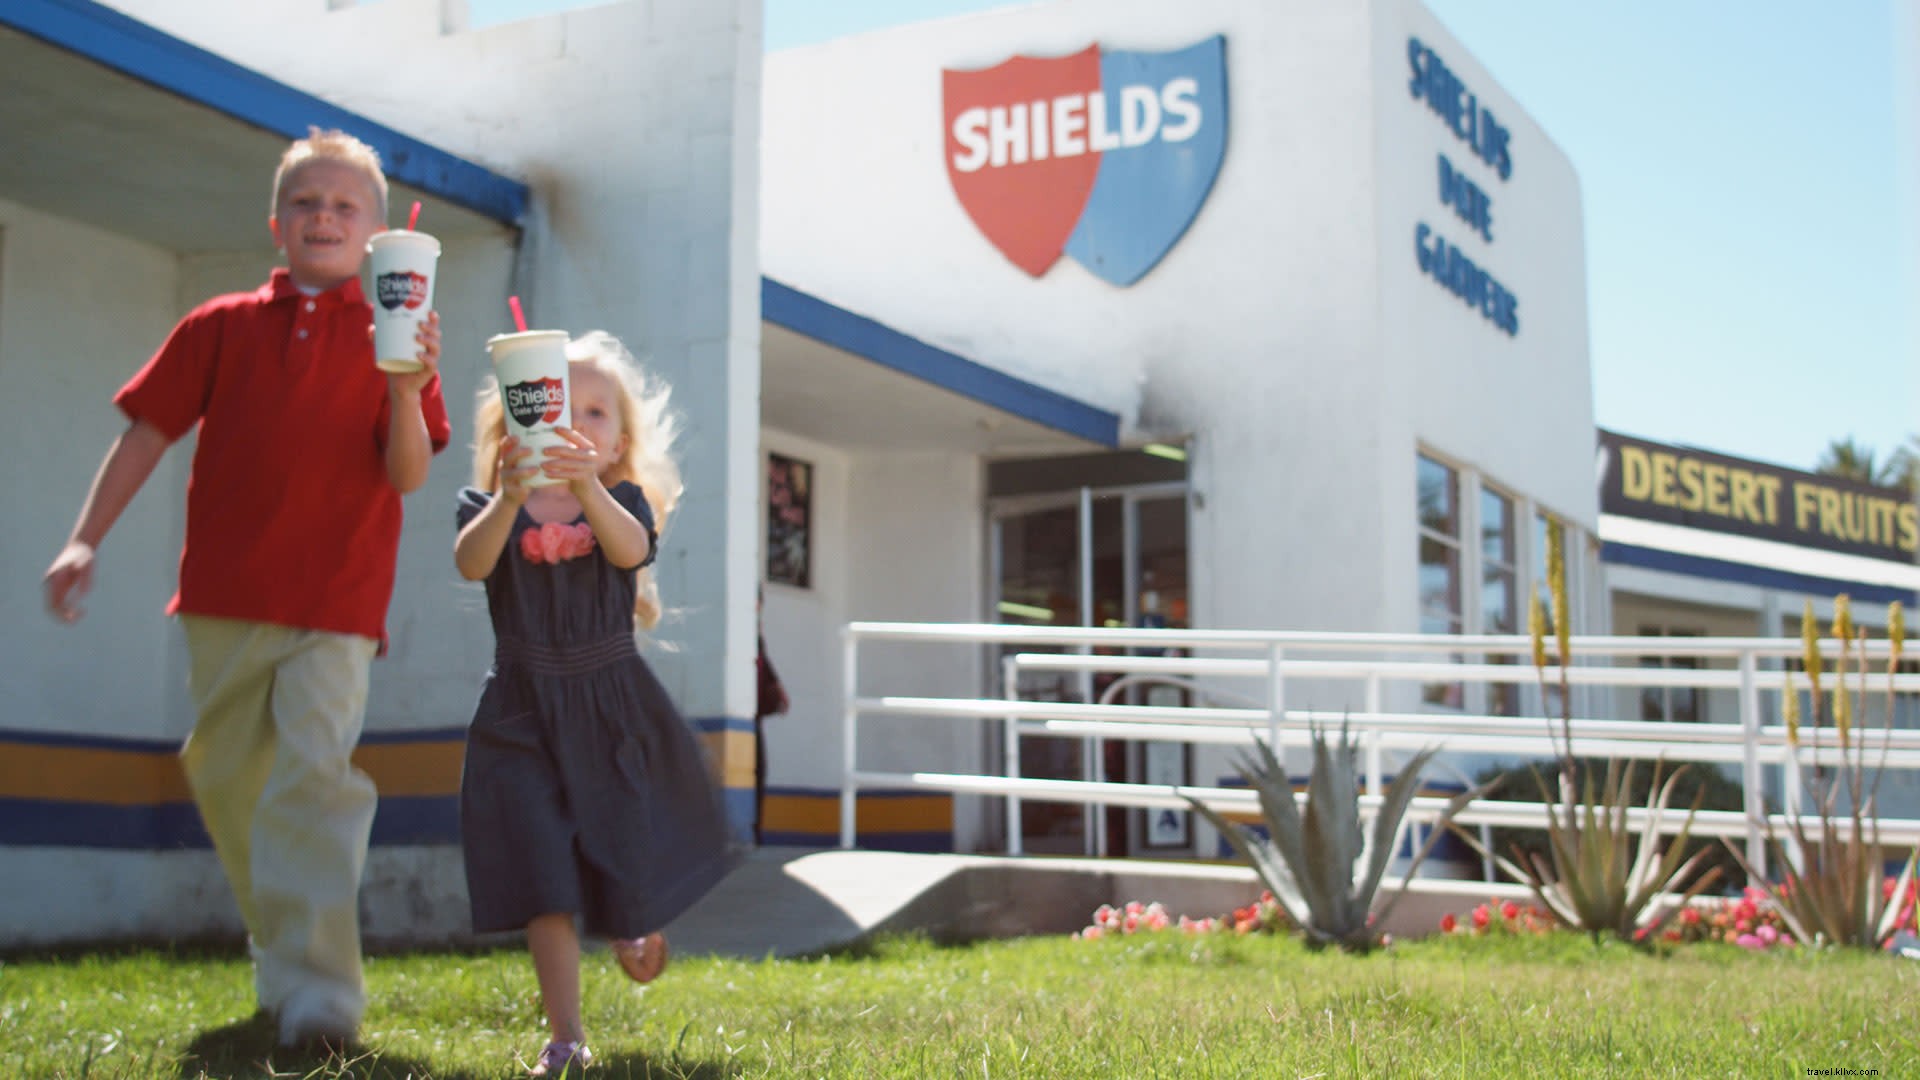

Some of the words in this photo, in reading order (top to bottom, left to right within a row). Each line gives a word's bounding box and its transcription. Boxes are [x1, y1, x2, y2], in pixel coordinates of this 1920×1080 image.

[952, 76, 1203, 172] SHIELDS
[1408, 36, 1512, 181] SHIELDS
[508, 385, 564, 407] Shields
[1620, 446, 1781, 526] DESERT
[1794, 480, 1920, 552] FRUITS
